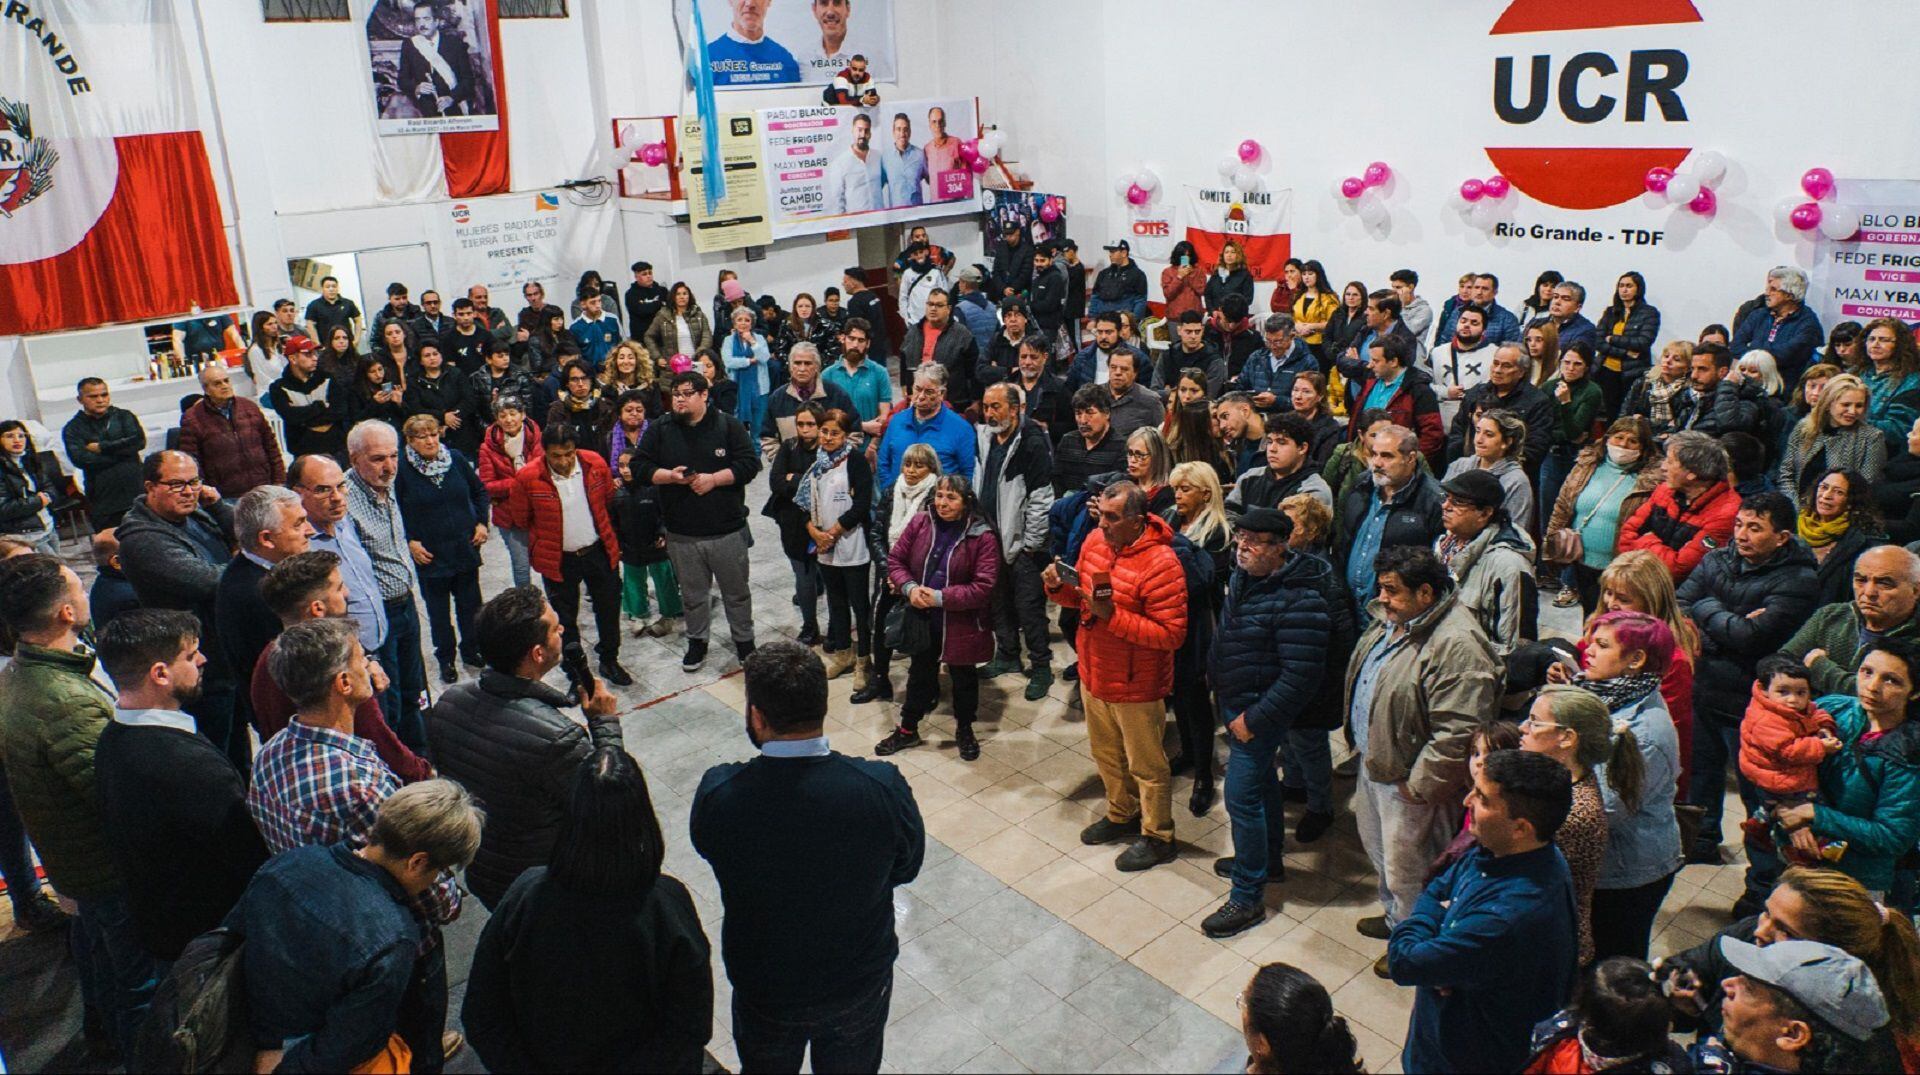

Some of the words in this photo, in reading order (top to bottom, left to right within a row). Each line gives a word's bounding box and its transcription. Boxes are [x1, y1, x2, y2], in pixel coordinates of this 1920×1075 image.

[0, 0, 91, 95] RANDE
[810, 60, 843, 68] YBARS
[1494, 49, 1690, 124] UCR
[767, 110, 797, 119] PABLO
[799, 107, 837, 119] BLANCO
[768, 137, 790, 146] FEDE
[792, 133, 833, 144] FRIGERIO
[774, 161, 796, 169] MAXI
[798, 158, 828, 168] YBARS
[944, 173, 966, 182] LISTA
[947, 182, 963, 193] 304
[780, 192, 823, 206] CAMBIO
[1199, 190, 1231, 203] COMITE
[1243, 192, 1271, 205] LOCAL
[452, 209, 471, 217] UCR
[456, 223, 500, 238] MUJERES
[504, 217, 558, 231] RADICALES
[1133, 222, 1169, 235] OTR
[1495, 222, 1526, 237] Río
[1530, 225, 1603, 241] Grande
[1621, 229, 1664, 245] TDF
[461, 238, 499, 249] TIERRA
[503, 233, 520, 243] DEL
[527, 229, 557, 241] FUEGO
[487, 245, 535, 259] PRESENTE
[1834, 251, 1878, 265] FEDE
[1880, 271, 1906, 281] VICE
[1834, 287, 1879, 301] MAXI
[1857, 306, 1917, 318] CONCEJAL
